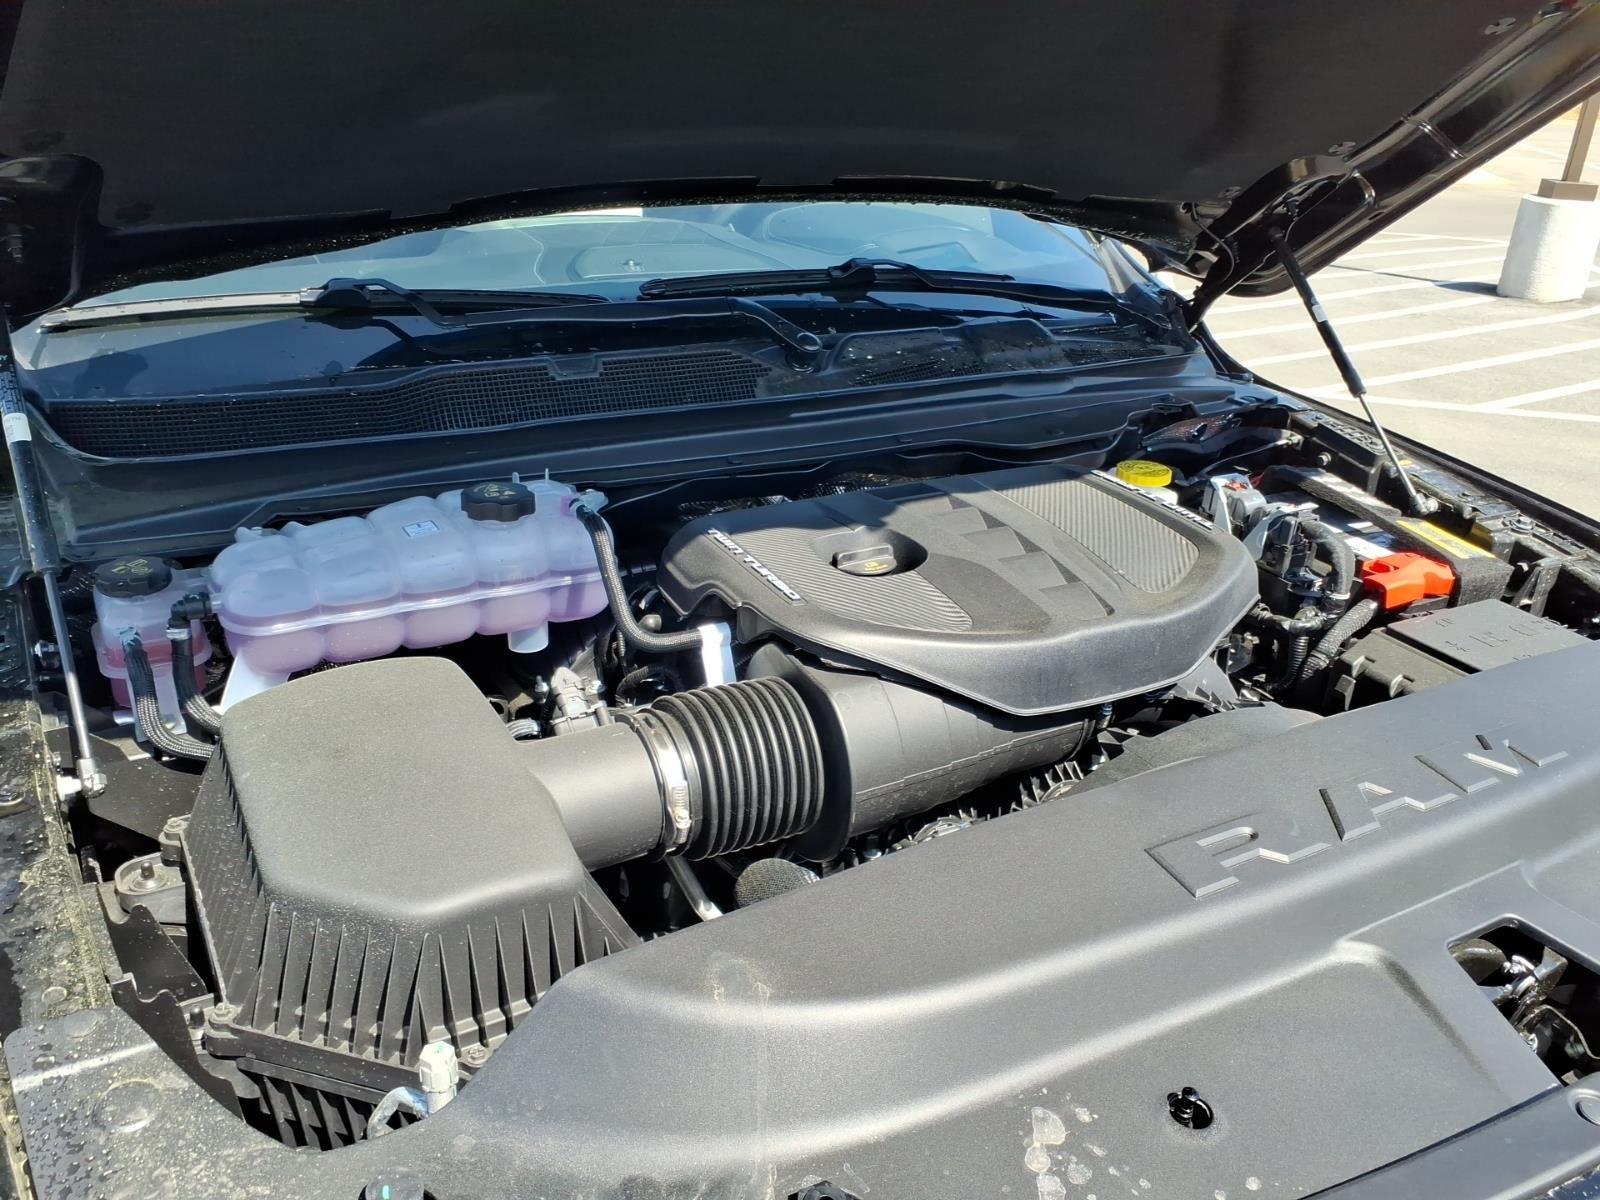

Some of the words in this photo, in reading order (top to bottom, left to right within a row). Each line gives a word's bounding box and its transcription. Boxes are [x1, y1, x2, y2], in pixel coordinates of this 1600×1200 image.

[707, 527, 745, 555] TWIN
[743, 554, 801, 601] TURBO
[1144, 733, 1569, 900] RAM
